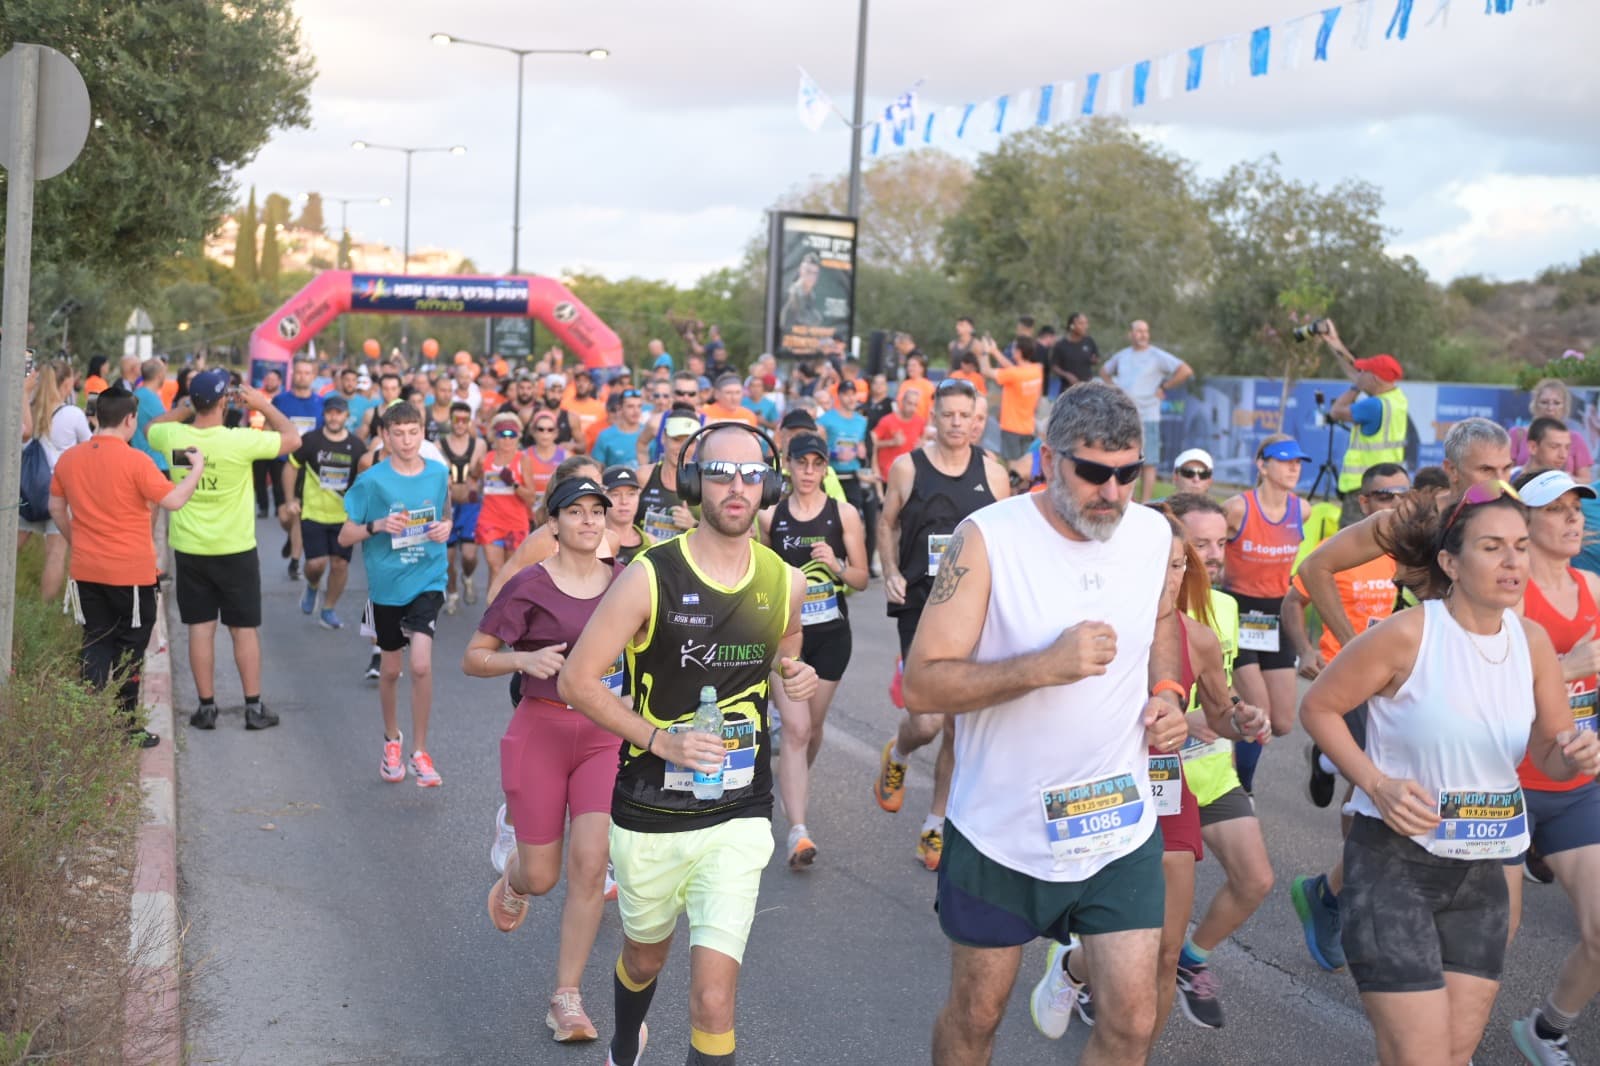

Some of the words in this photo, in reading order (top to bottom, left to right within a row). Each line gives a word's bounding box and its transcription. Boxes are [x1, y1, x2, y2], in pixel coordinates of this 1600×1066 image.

[718, 644, 766, 661] FITNESS
[1068, 786, 1091, 800] אתא
[1464, 793, 1486, 804] אתא
[1079, 811, 1122, 834] 1086
[1467, 822, 1508, 838] 1067
